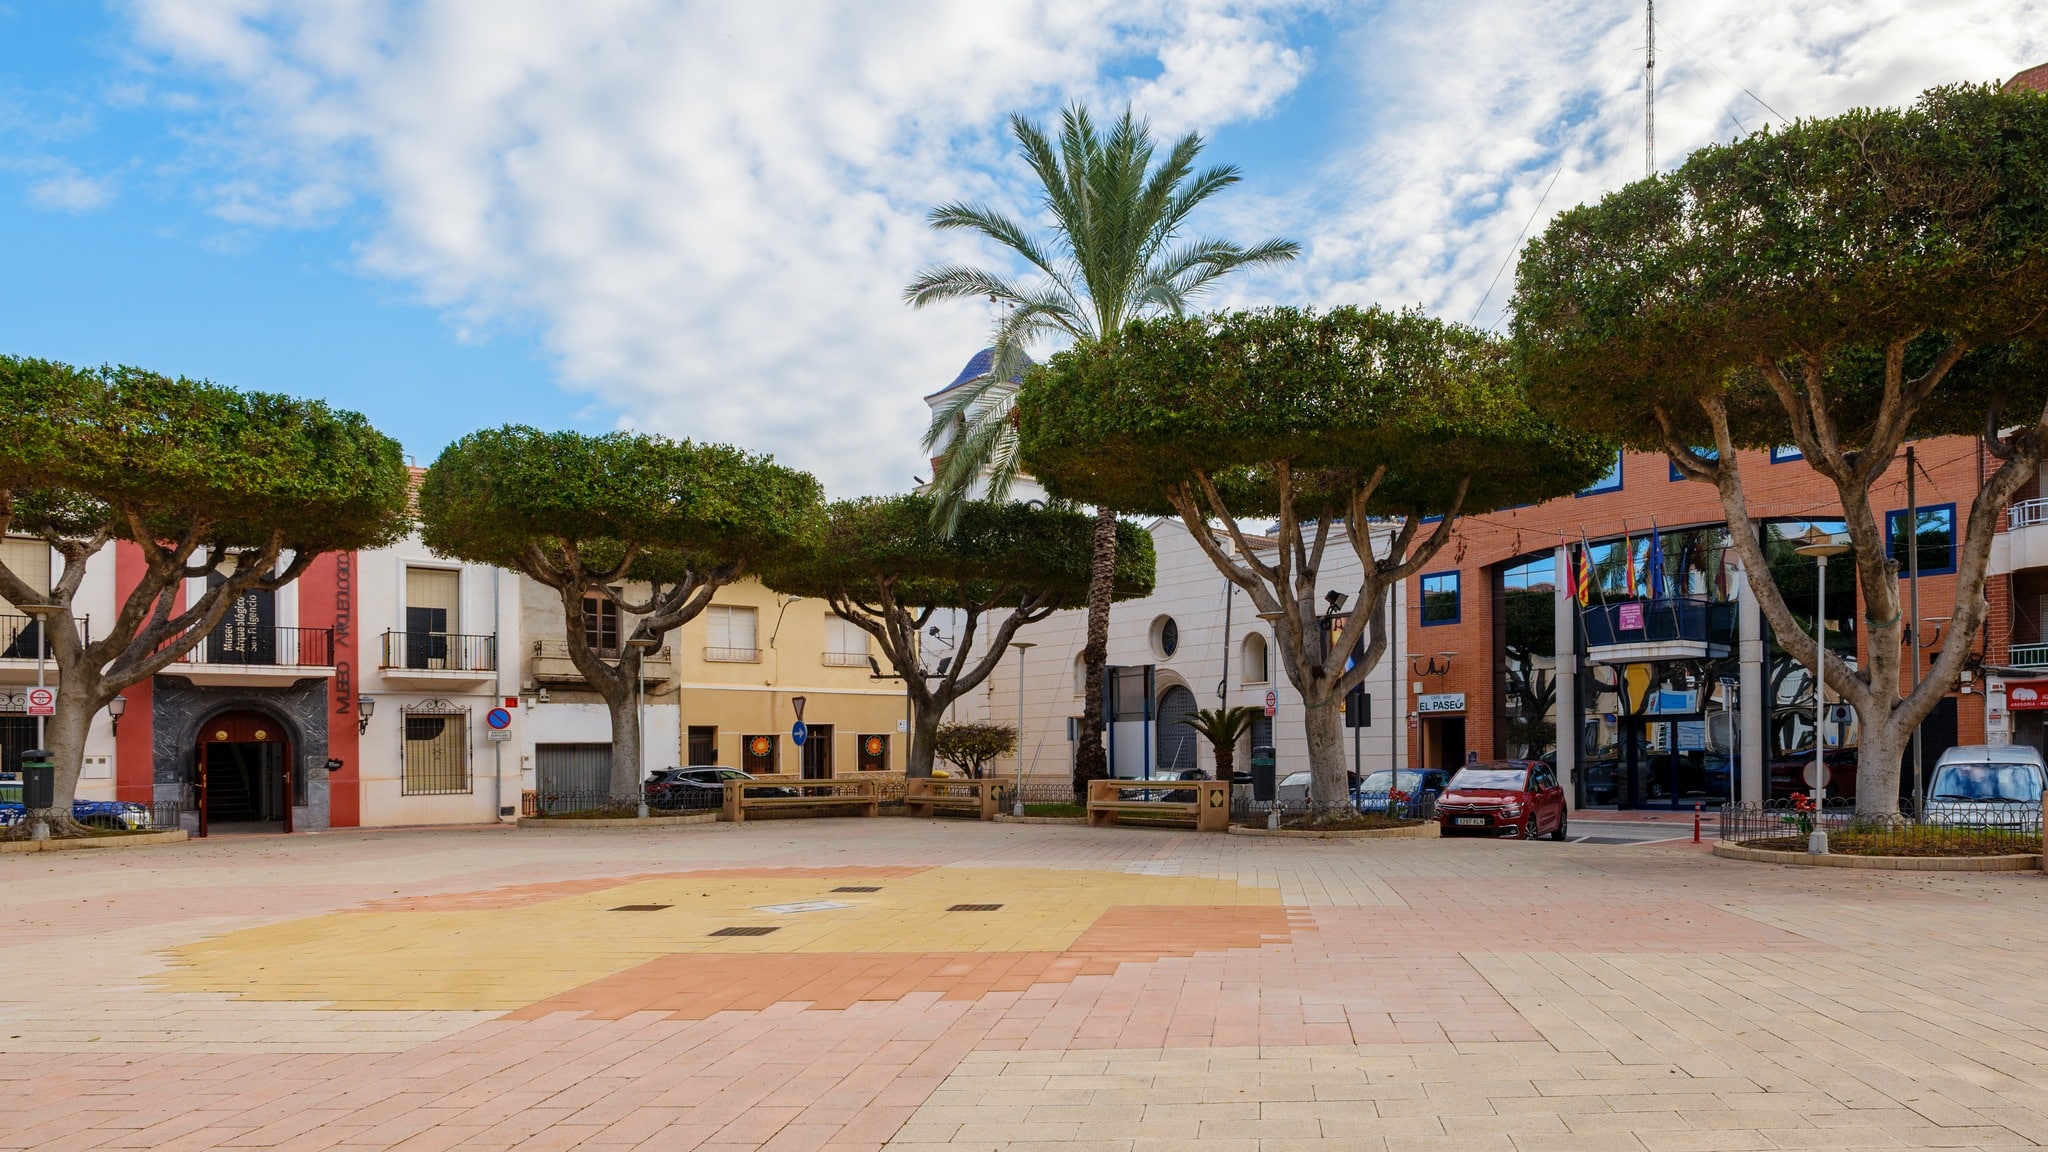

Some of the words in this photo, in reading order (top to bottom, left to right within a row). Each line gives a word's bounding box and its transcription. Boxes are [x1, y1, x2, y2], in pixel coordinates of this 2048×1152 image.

[223, 623, 233, 651] Museo
[336, 661, 350, 714] MUSEO
[1419, 702, 1430, 711] EL
[1432, 700, 1464, 710] PASEO
